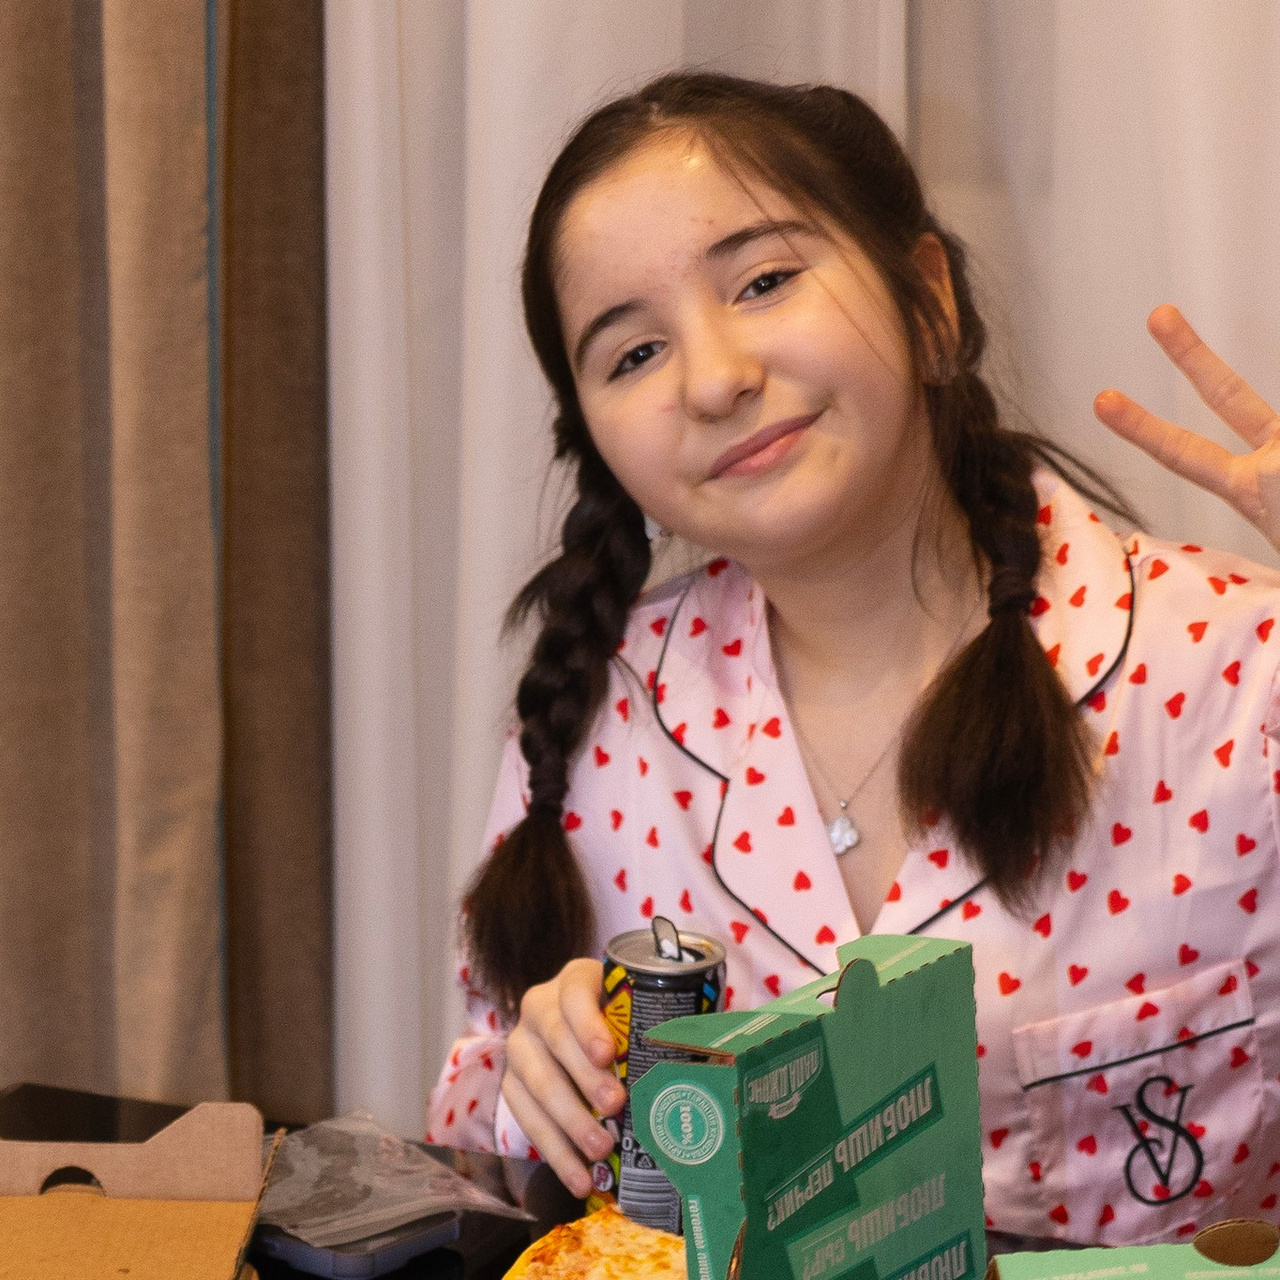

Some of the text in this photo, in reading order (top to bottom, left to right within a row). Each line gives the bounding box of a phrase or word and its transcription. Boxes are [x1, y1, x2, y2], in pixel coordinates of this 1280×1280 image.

[680, 1105, 693, 1145] 100%
[767, 1073, 934, 1232] ЛЮБИШЬ ПЕРЧИК?
[847, 1173, 945, 1256] ЛЮБИШЬ
